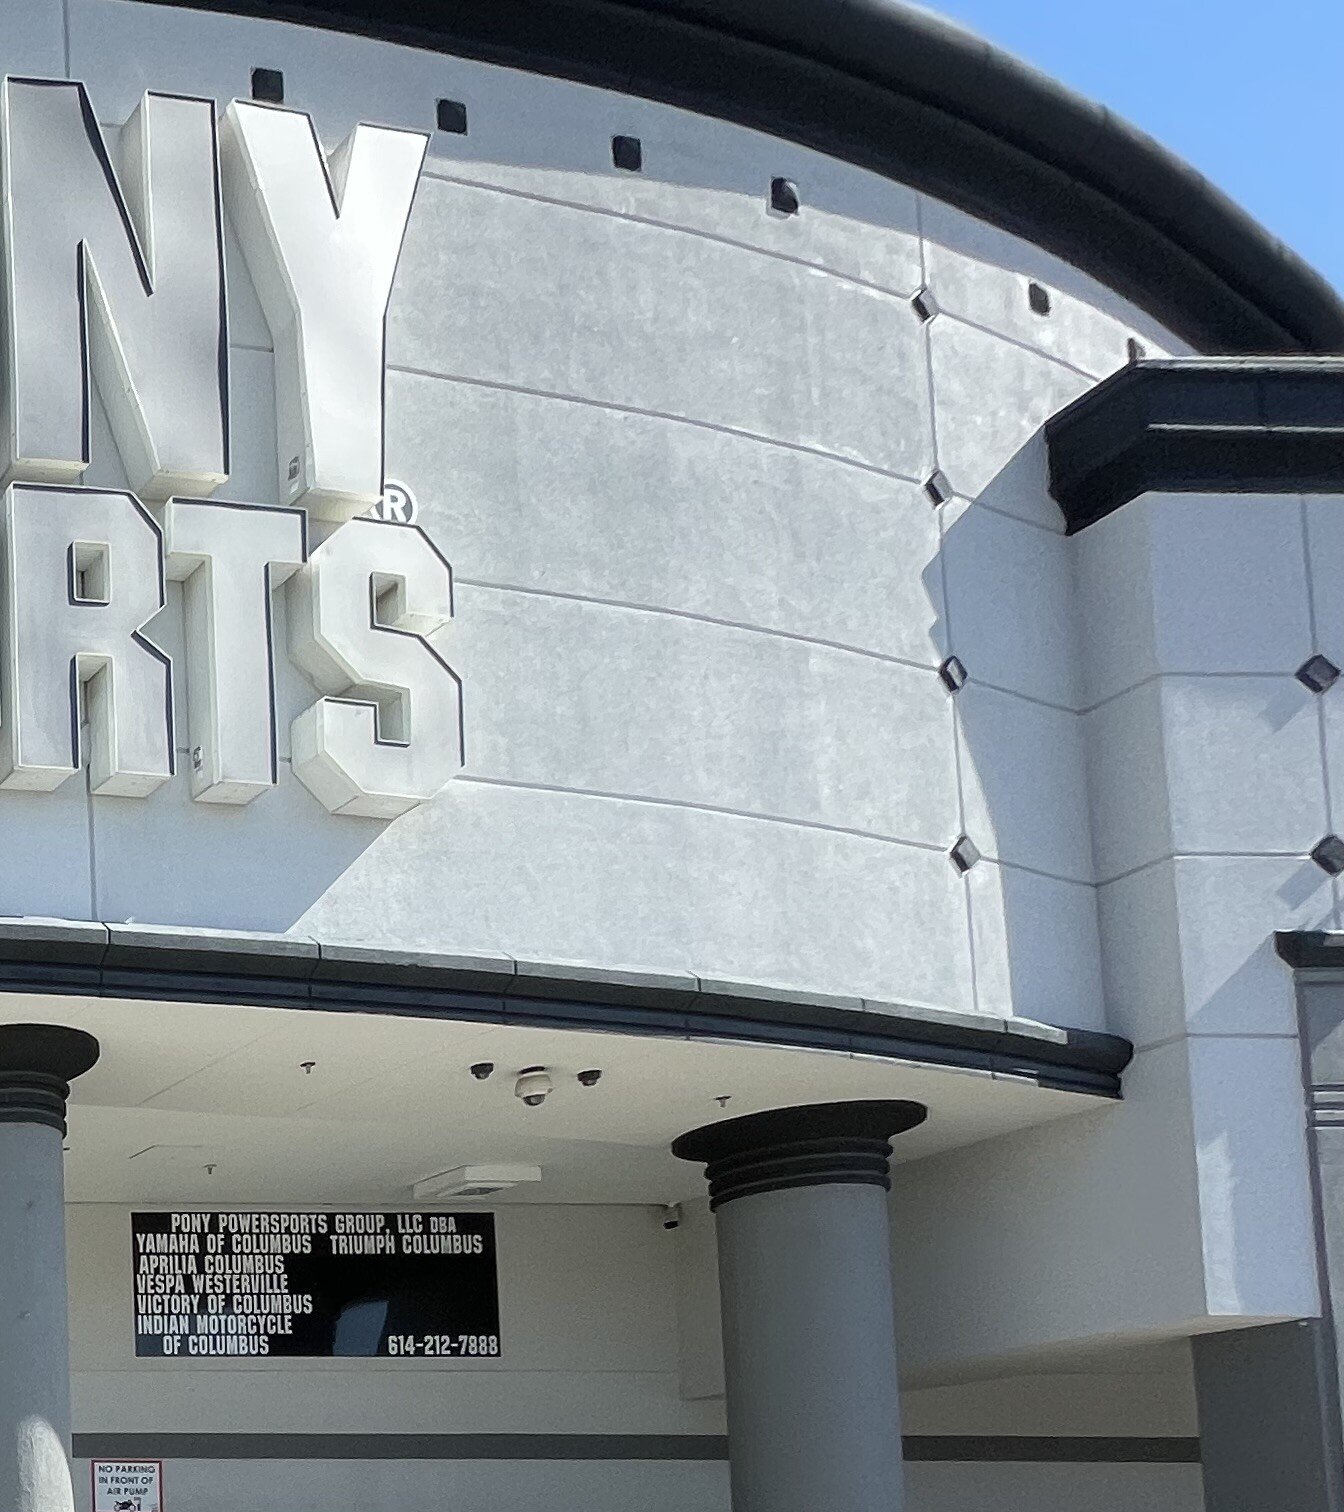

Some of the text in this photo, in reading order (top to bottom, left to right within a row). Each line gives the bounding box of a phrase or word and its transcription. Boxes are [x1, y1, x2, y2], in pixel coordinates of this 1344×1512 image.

[171, 1214, 456, 1235] PONY POWERSPORTS GROUP, LLC DBA
[136, 1234, 311, 1254] YAMAHA OF COLUMBUS
[330, 1235, 482, 1254] TRIUMPH COLUMBUS
[140, 1255, 284, 1274] APRILIA COLUMBUS
[137, 1275, 289, 1294] VESPA WESTERVILLE
[137, 1295, 312, 1314] VICTORY OF COLUMBUS
[138, 1315, 292, 1334] INDIAN MOTORCYCLE
[163, 1336, 268, 1355] OF COLUMBUS
[388, 1336, 497, 1355] 614-212-7888
